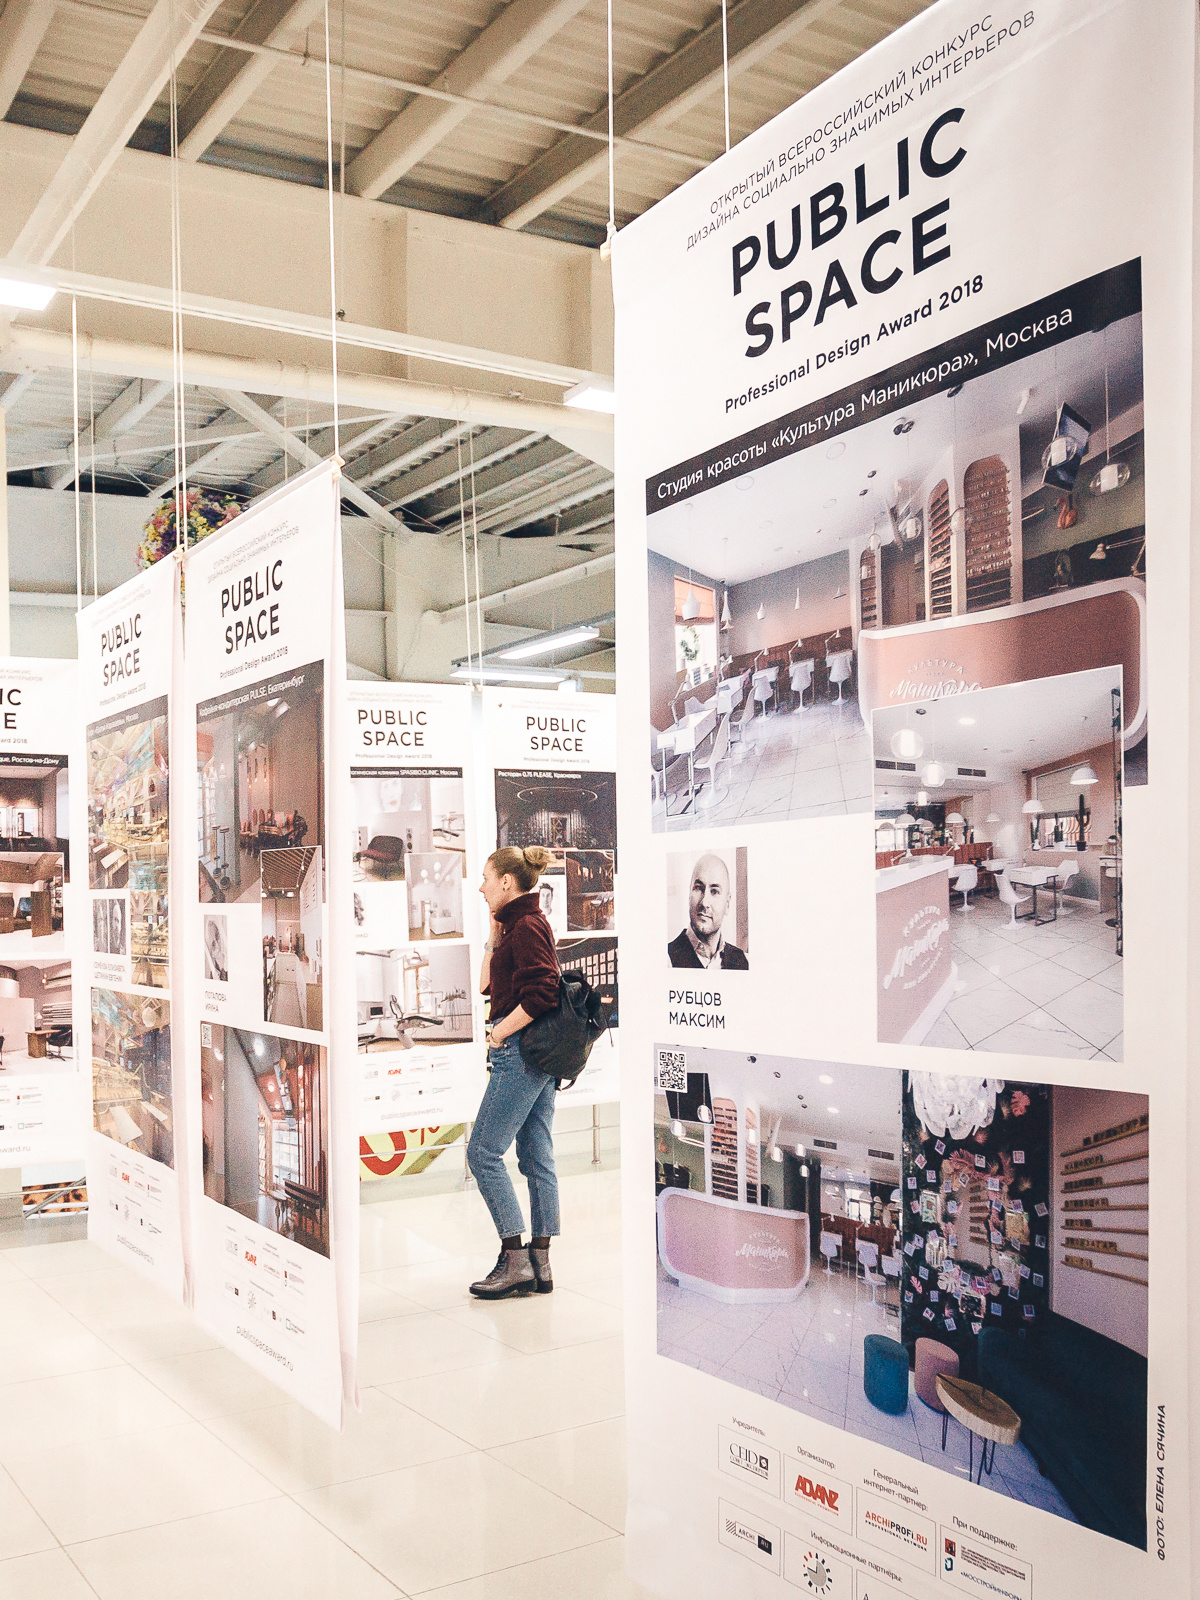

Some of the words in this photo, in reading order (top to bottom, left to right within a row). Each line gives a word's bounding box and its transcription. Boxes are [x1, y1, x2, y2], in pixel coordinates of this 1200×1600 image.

[687, 205, 740, 252] ДИЗАЙНА
[743, 147, 825, 210] СОЦИАЛЬНО
[830, 87, 914, 155] ЗНАЧИМЫХ
[919, 10, 1036, 96] ИНТЕРЬЕРОВ
[710, 158, 775, 214] ОТКРЫТЫЙ
[778, 69, 907, 167] ВСЕРОССИЙСКИЙ
[912, 14, 993, 77] КОНКУРС
[732, 107, 968, 297] PUBLIC
[744, 197, 952, 358] SPACE
[724, 359, 810, 414] Professional
[816, 329, 871, 378] Design
[876, 303, 932, 343] Award
[939, 275, 984, 312] 2018
[657, 468, 703, 501] Студия
[707, 442, 767, 476] красоты
[771, 402, 856, 452] «Культура
[860, 350, 979, 411] Маникюра»,
[986, 306, 1074, 358] Москва
[221, 559, 283, 618] PUBLIC
[101, 613, 142, 657] PUBLIC
[225, 602, 280, 655] SPACE
[103, 648, 140, 686] SPACE
[220, 663, 244, 680] Professional
[245, 659, 260, 669] Design
[261, 651, 276, 662] Award
[276, 645, 289, 658] 2018
[357, 709, 428, 726] PUBLIC
[363, 731, 425, 747] SPACE
[526, 716, 586, 733] PUBLIC
[530, 736, 584, 752] SPACE
[668, 990, 723, 1008] РУБЦОВ
[668, 1012, 726, 1030] МАКСИМ
[236, 1325, 294, 1372] publicspaceaward.ru
[1156, 1404, 1166, 1461] СЯЧИНА
[796, 1445, 836, 1470] Организатор:
[873, 1468, 919, 1495] Генеральный
[1155, 1466, 1165, 1513] ЕЛЕНА
[810, 1530, 867, 1566] Информационные
[952, 1515, 968, 1531] При
[969, 1525, 1018, 1551] поддержке:
[1156, 1516, 1166, 1561] ФОТО:
